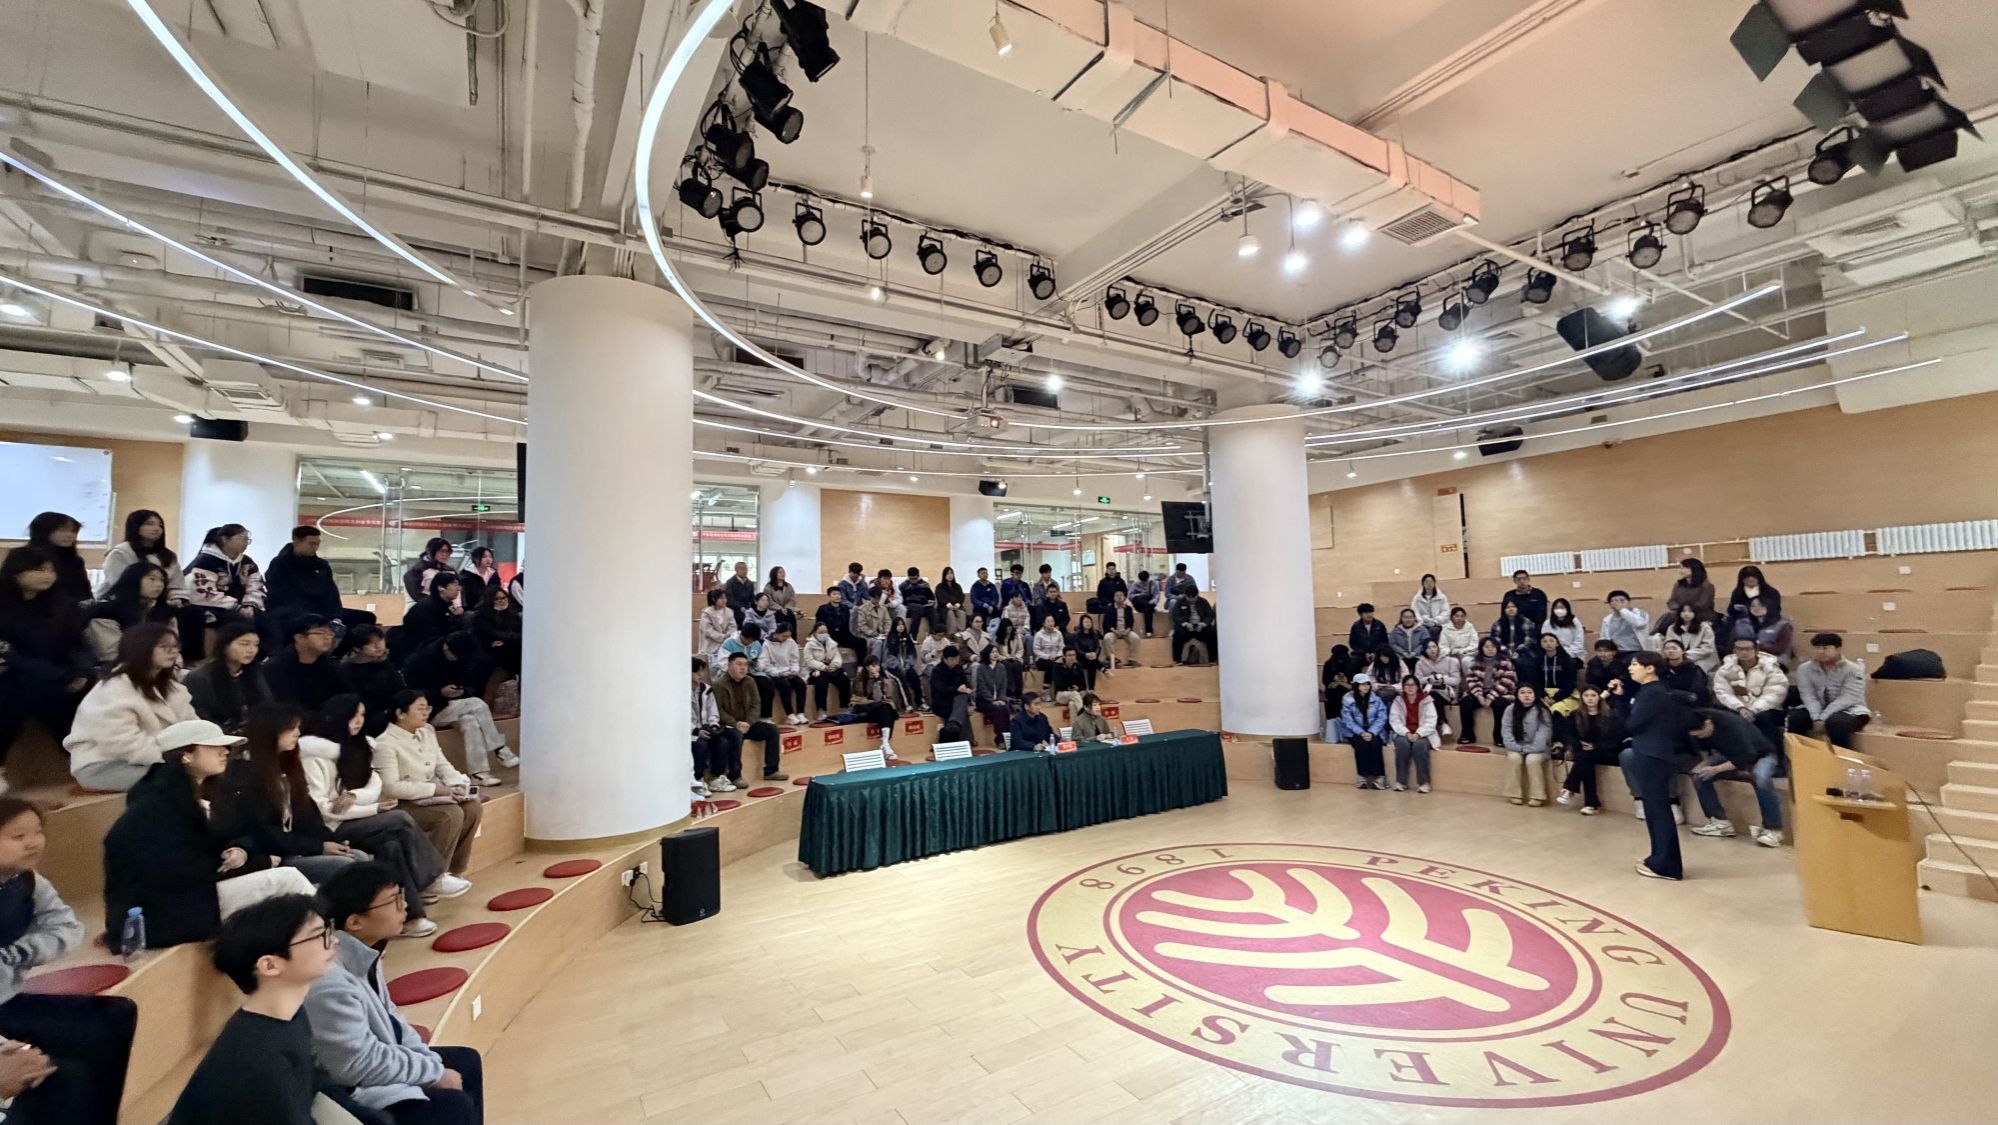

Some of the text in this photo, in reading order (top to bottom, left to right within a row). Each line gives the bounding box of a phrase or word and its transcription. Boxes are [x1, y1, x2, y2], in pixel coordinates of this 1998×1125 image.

[1079, 848, 1234, 890] 1898
[1054, 856, 1690, 1087] PEKING UNIVERSITY
